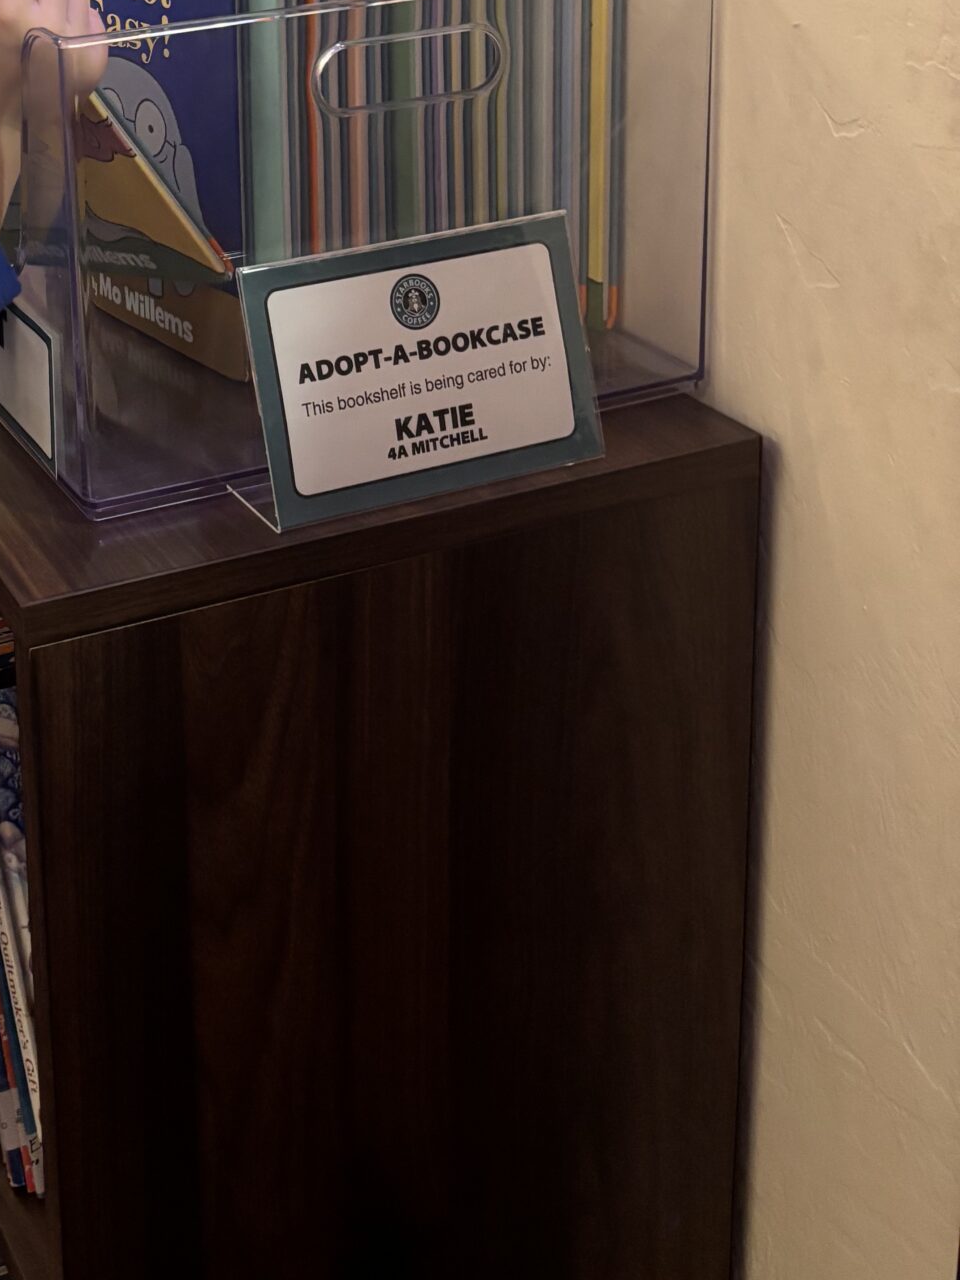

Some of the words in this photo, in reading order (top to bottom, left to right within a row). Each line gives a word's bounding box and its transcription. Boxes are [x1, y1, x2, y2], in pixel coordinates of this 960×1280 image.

[395, 279, 434, 305] STARBOOKS
[98, 280, 122, 306] Mo
[124, 285, 194, 344] Willems
[402, 311, 431, 325] COFFEE
[298, 316, 546, 385] ADOPT-A-BOOKCASE
[301, 399, 334, 419] This
[337, 382, 407, 412] bookshelf
[410, 381, 423, 398] is
[425, 372, 465, 395] being
[467, 363, 507, 384] cared
[508, 357, 528, 375] for
[530, 354, 552, 374] by:
[394, 403, 476, 441] KATIE
[387, 445, 409, 461] 4A
[411, 427, 488, 456] MITCHELL
[23, 1055, 38, 1096] Gift
